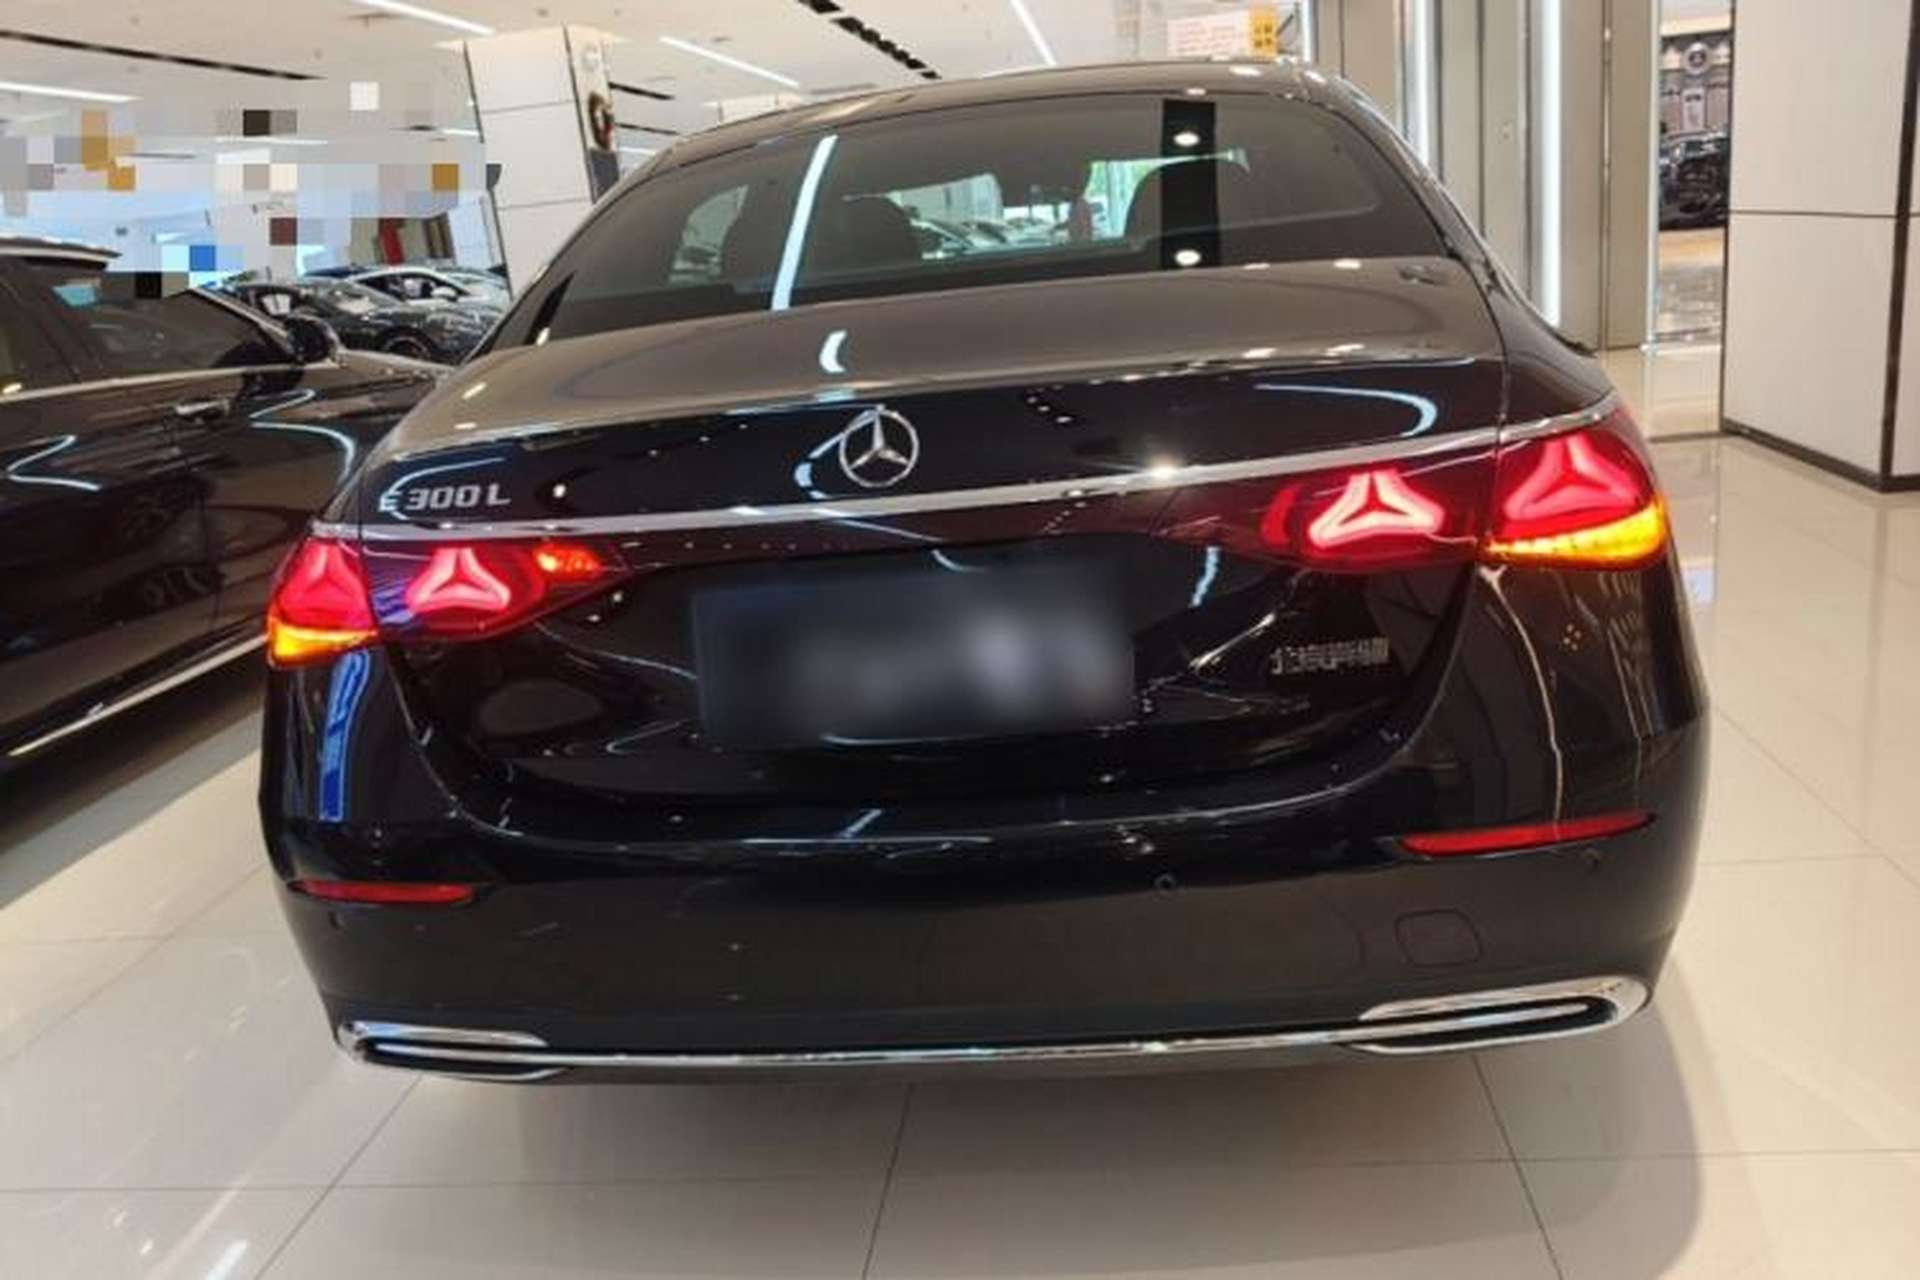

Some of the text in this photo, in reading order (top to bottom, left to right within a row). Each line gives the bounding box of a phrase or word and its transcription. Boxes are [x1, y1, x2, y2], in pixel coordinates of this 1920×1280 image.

[378, 483, 511, 511] E 300 L
